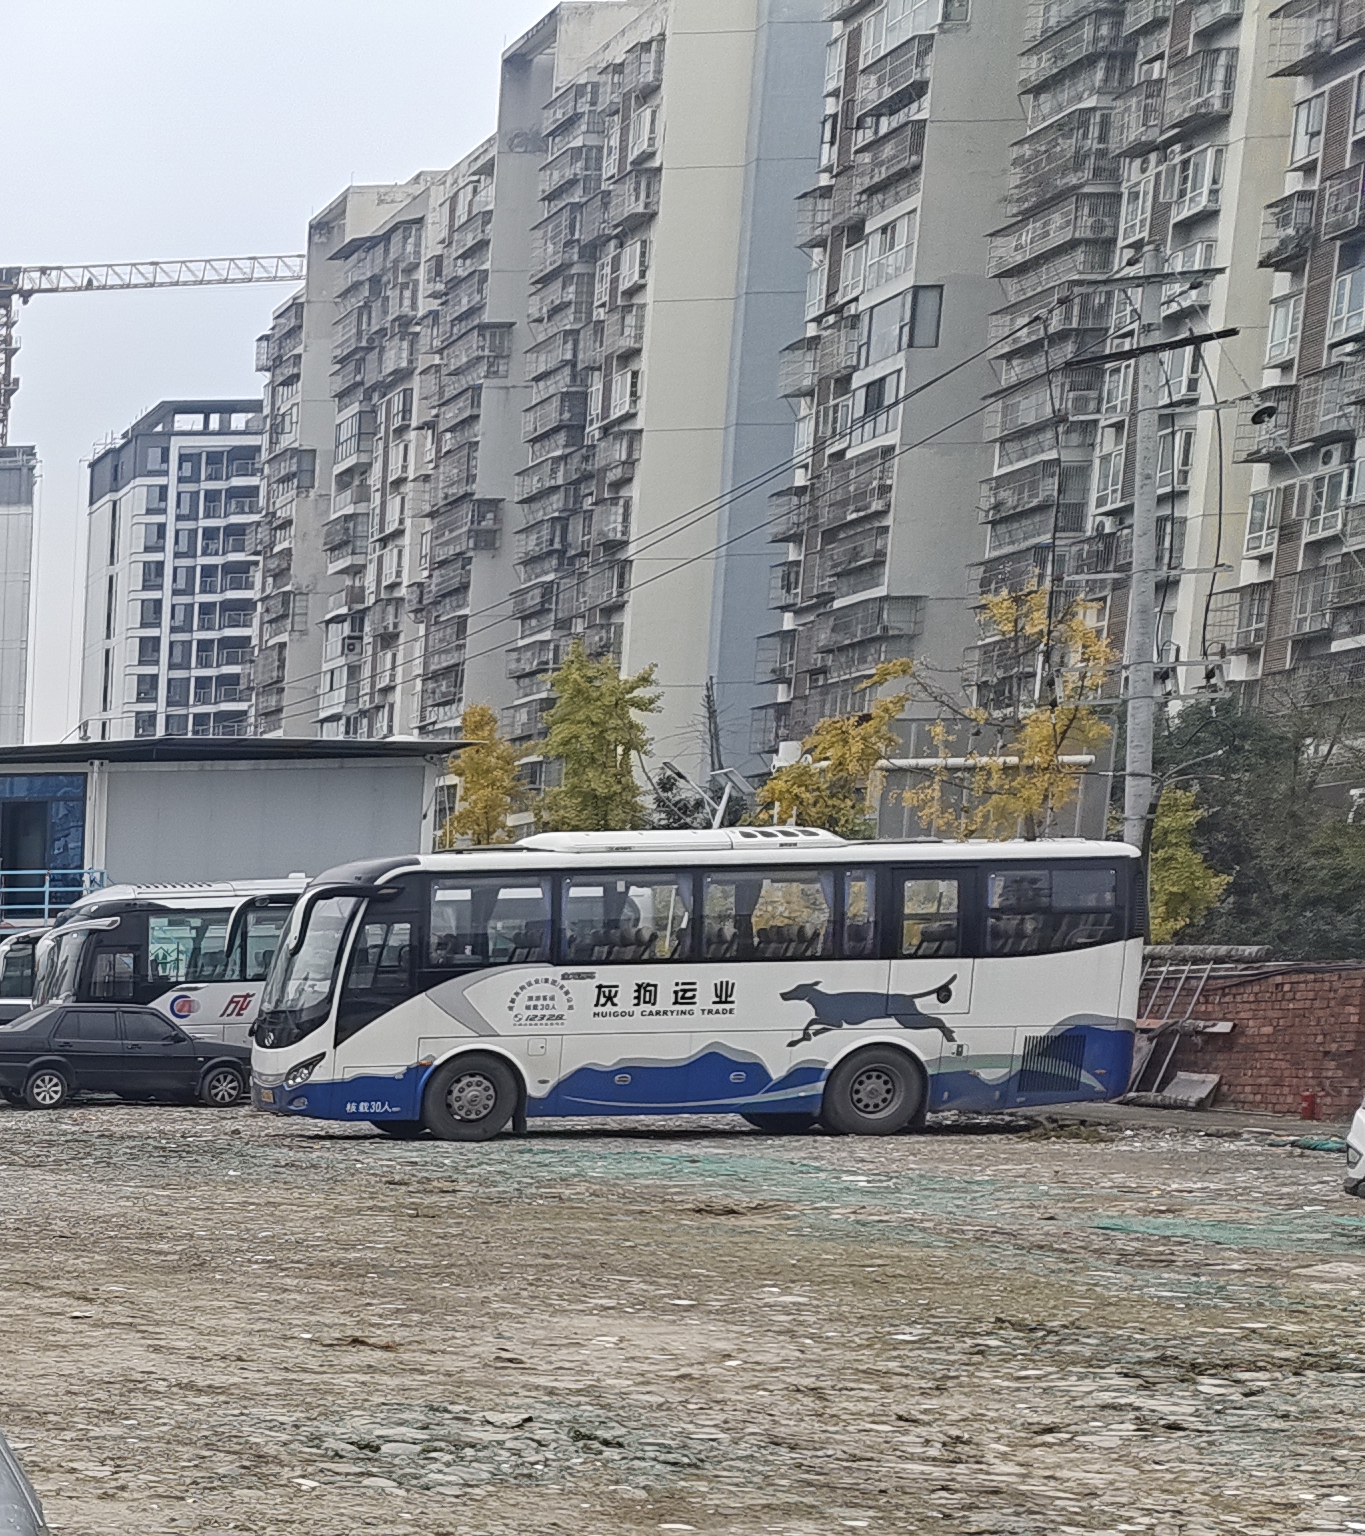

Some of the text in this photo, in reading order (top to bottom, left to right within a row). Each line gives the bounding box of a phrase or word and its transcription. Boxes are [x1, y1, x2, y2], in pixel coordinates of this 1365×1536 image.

[593, 980, 736, 1008] 灰狗运业
[592, 1007, 736, 1018] HUIGOU CARRYING TRADE
